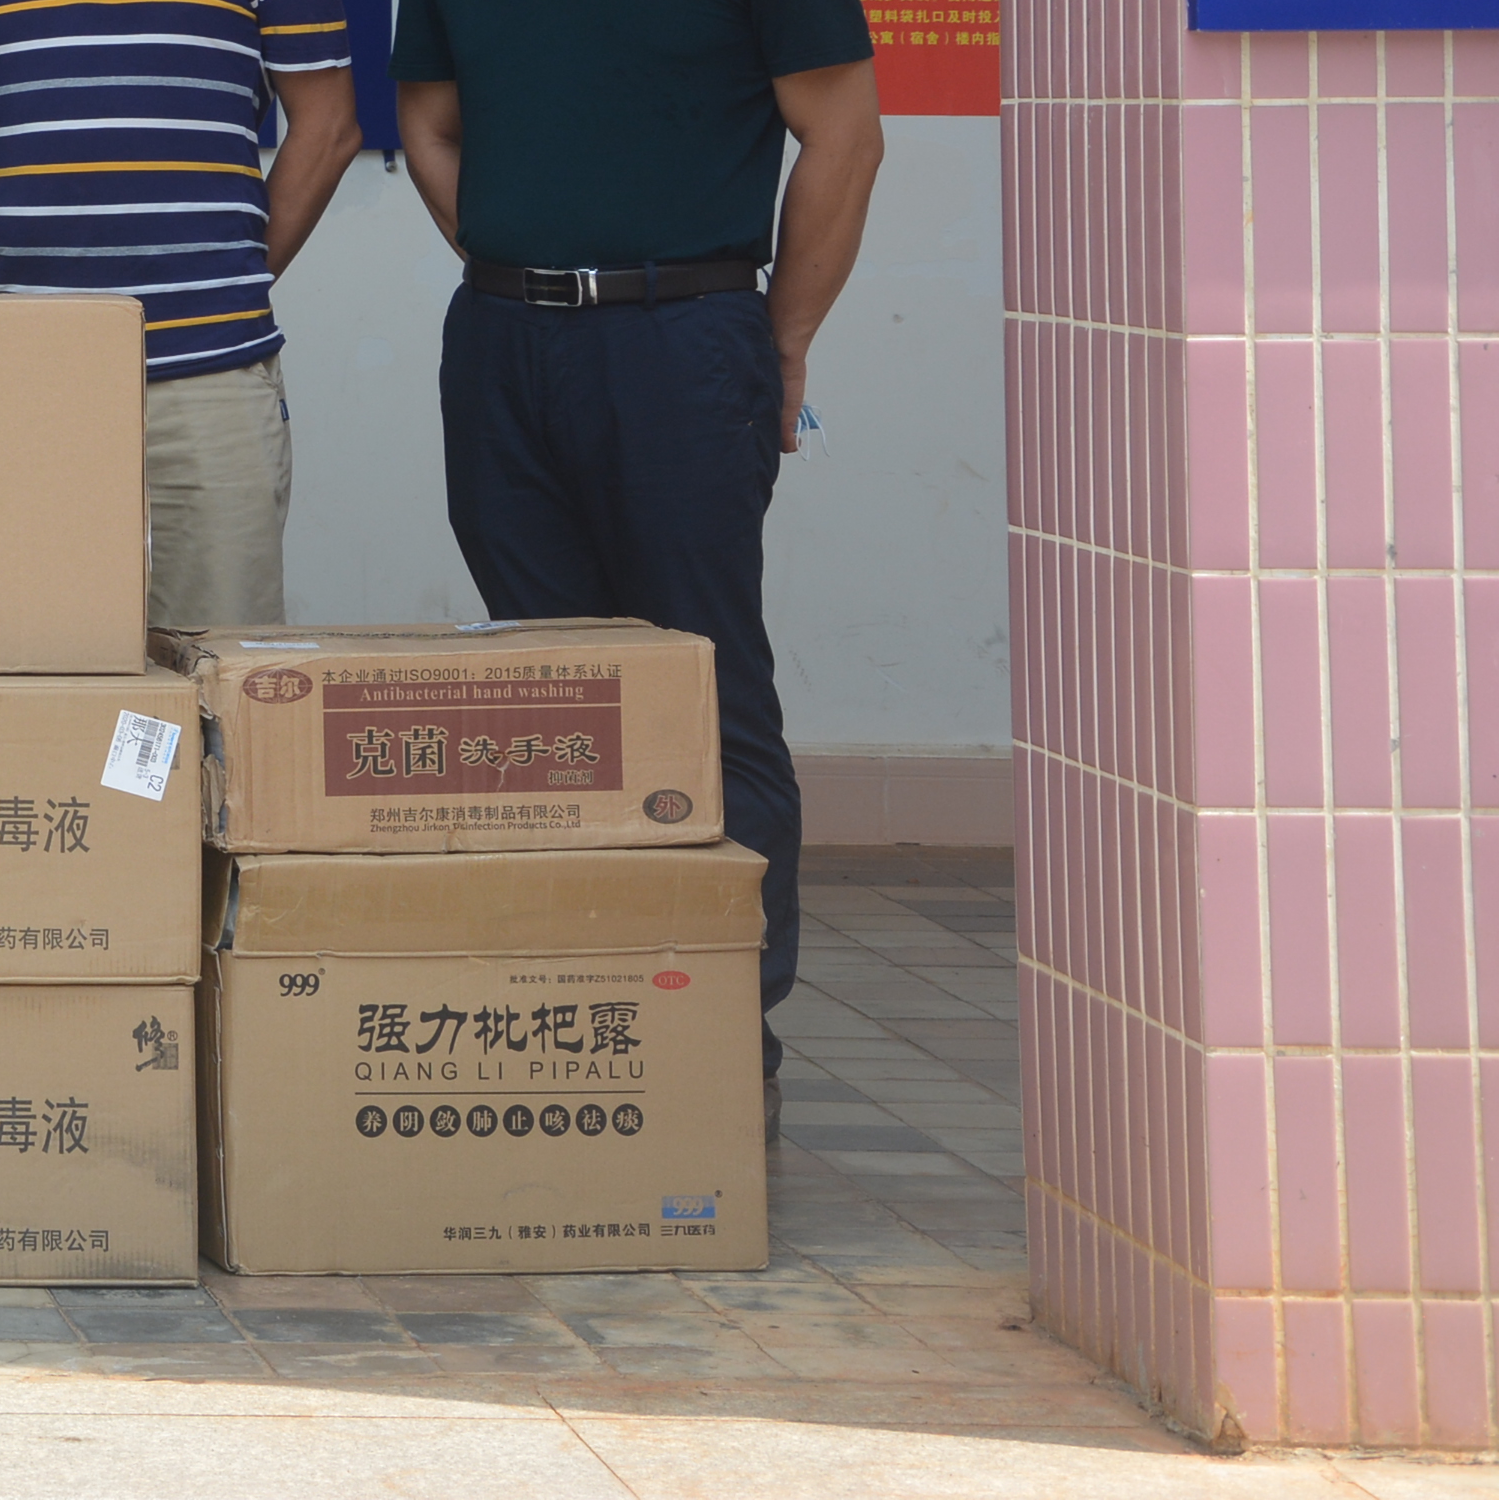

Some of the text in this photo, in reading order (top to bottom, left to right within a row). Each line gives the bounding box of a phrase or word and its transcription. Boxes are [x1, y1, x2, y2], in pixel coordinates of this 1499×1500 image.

[255, 675, 300, 699] 吉尔
[360, 683, 584, 702] Antibacterial hand washing
[548, 770, 594, 785] 抑菌剂
[370, 804, 581, 822] 郑州吉尔康消毒制品有限公司
[651, 795, 682, 820] 外
[370, 822, 420, 833] Zhengzhou
[508, 820, 548, 830] Products
[279, 973, 319, 997] 999
[658, 975, 685, 987] OTC
[357, 1002, 642, 1056] 强力枇杷露
[355, 1061, 644, 1081] QIANG LI PIPALU
[359, 1108, 641, 1134] 养阴敛肺止咳祛痰
[671, 1197, 703, 1217] 999
[443, 1223, 651, 1241] 华润三九（雅安）药业有限公司
[660, 1225, 715, 1237] 三九医药
